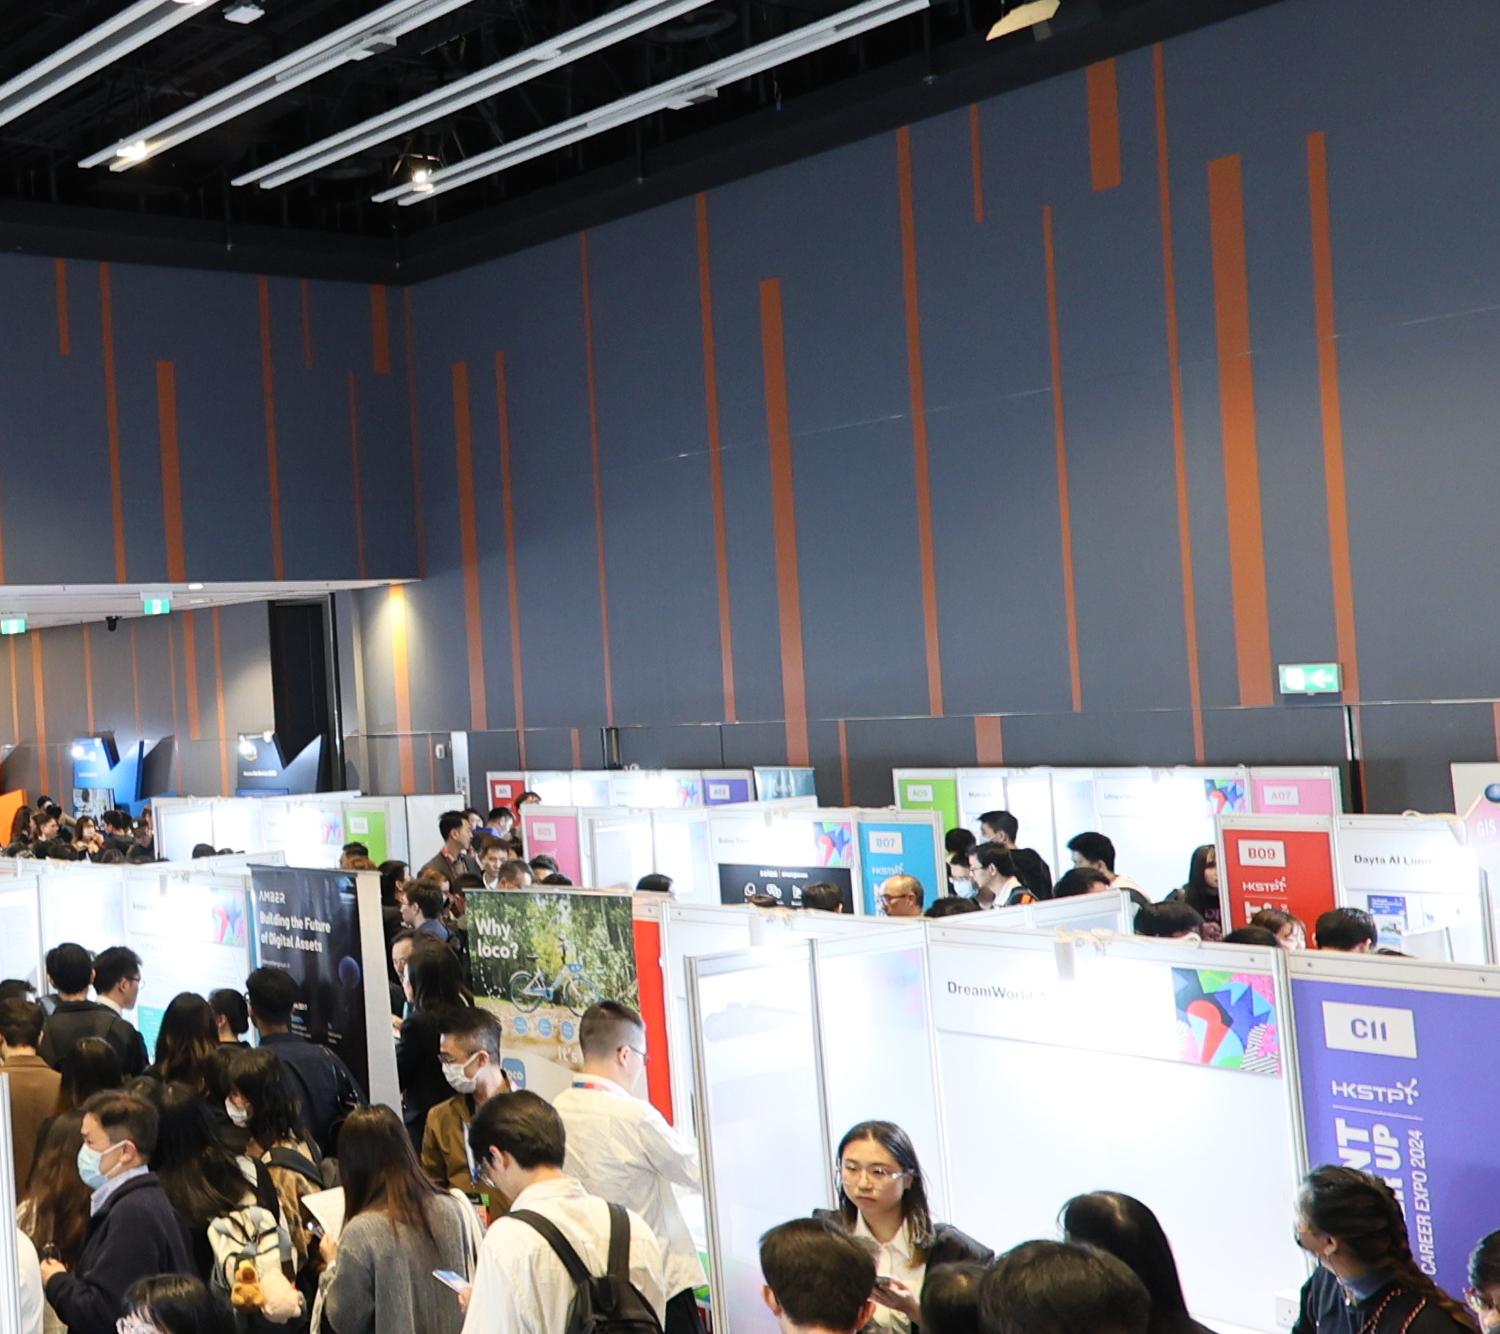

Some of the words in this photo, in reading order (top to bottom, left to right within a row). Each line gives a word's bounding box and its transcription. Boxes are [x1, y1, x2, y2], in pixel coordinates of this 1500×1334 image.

[1271, 791, 1292, 801] A07
[1476, 818, 1497, 838] GIS
[876, 838, 896, 849] B07
[1248, 847, 1276, 861] B09
[1354, 854, 1386, 866] Dayta
[1388, 855, 1400, 865] AI
[259, 890, 286, 905] AMBER
[1243, 881, 1280, 893] HKSTP
[260, 910, 290, 931] Building
[291, 913, 303, 930] the
[304, 916, 332, 934] Future
[475, 917, 511, 941] Why
[260, 932, 268, 945] of
[269, 934, 294, 951] Digital
[295, 937, 323, 954] Assets
[477, 939, 519, 959] loco?
[947, 979, 1033, 1001] DreamWorld
[1331, 1080, 1404, 1104] HKSTP
[1373, 1123, 1402, 1171] UP
[1408, 1129, 1427, 1169] 2024
[1411, 1170, 1430, 1212] EXPO
[1416, 1212, 1437, 1276] CAREER
